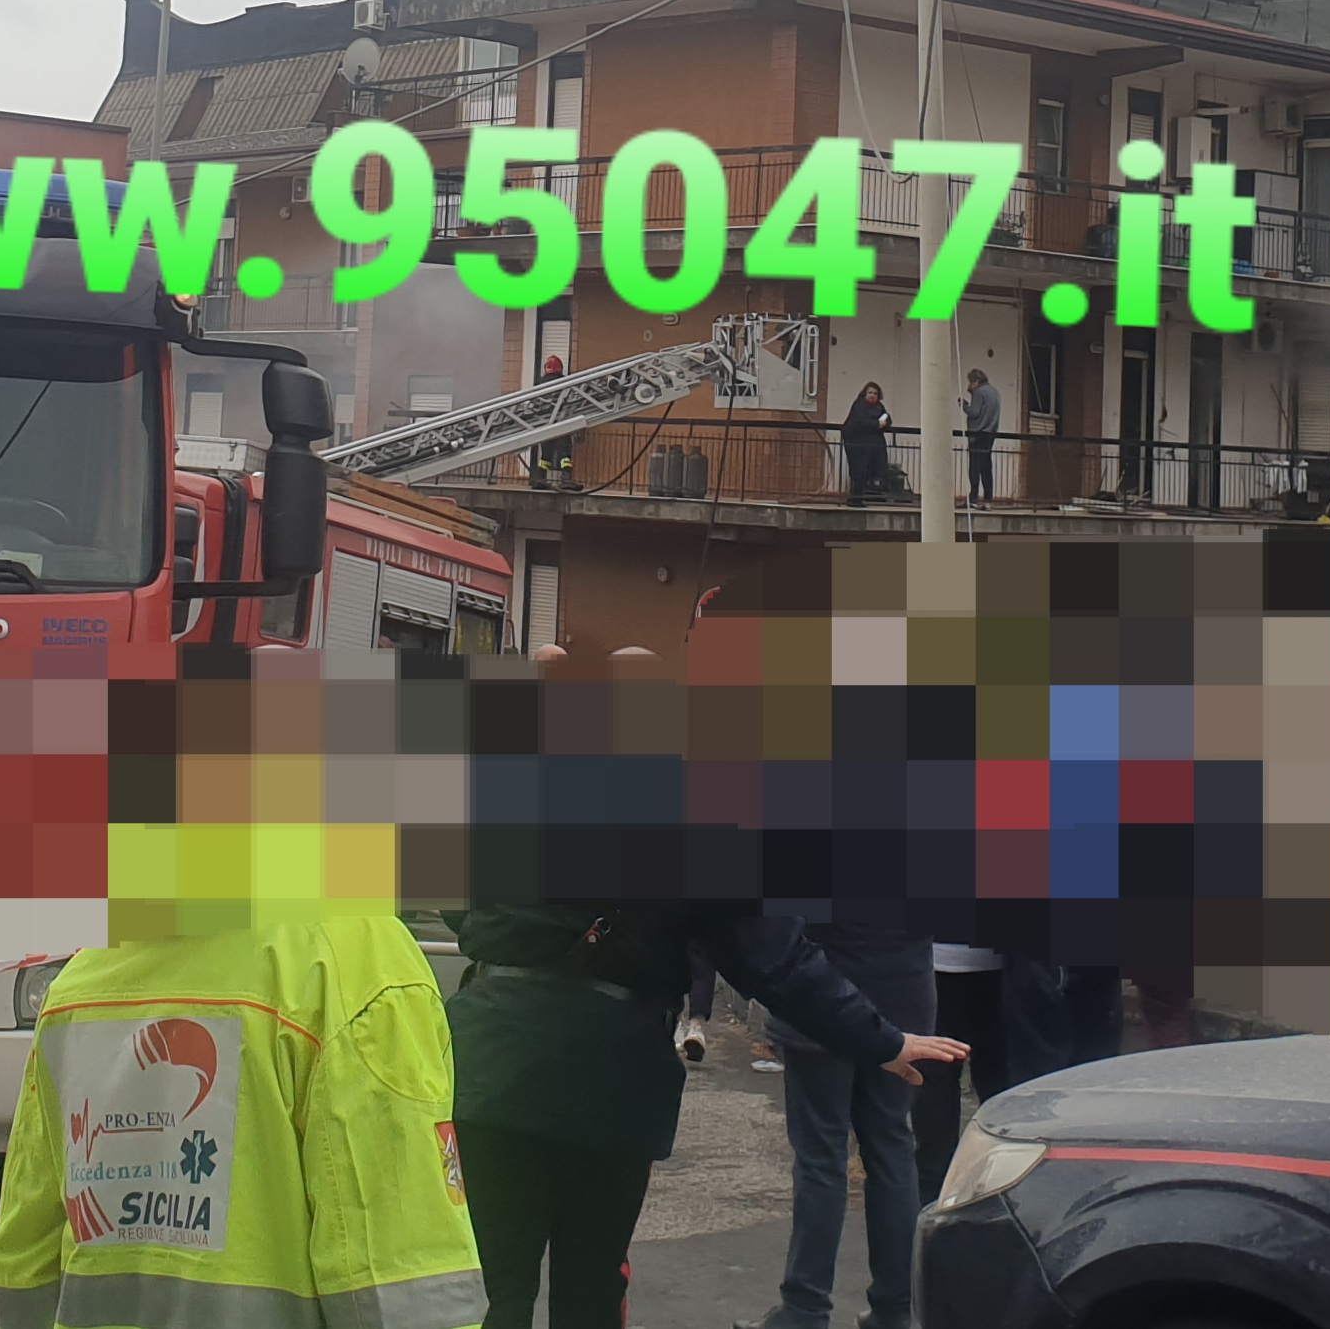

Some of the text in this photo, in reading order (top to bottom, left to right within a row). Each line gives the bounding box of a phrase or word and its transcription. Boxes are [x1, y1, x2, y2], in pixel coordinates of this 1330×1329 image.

[365, 537, 403, 564] VIGILI
[411, 550, 431, 572] DEL
[43, 618, 109, 634] IVECO
[104, 1111, 176, 1128] PRO-ENZA
[118, 1191, 211, 1231] SICILIA
[118, 1227, 164, 1241] REGIONE
